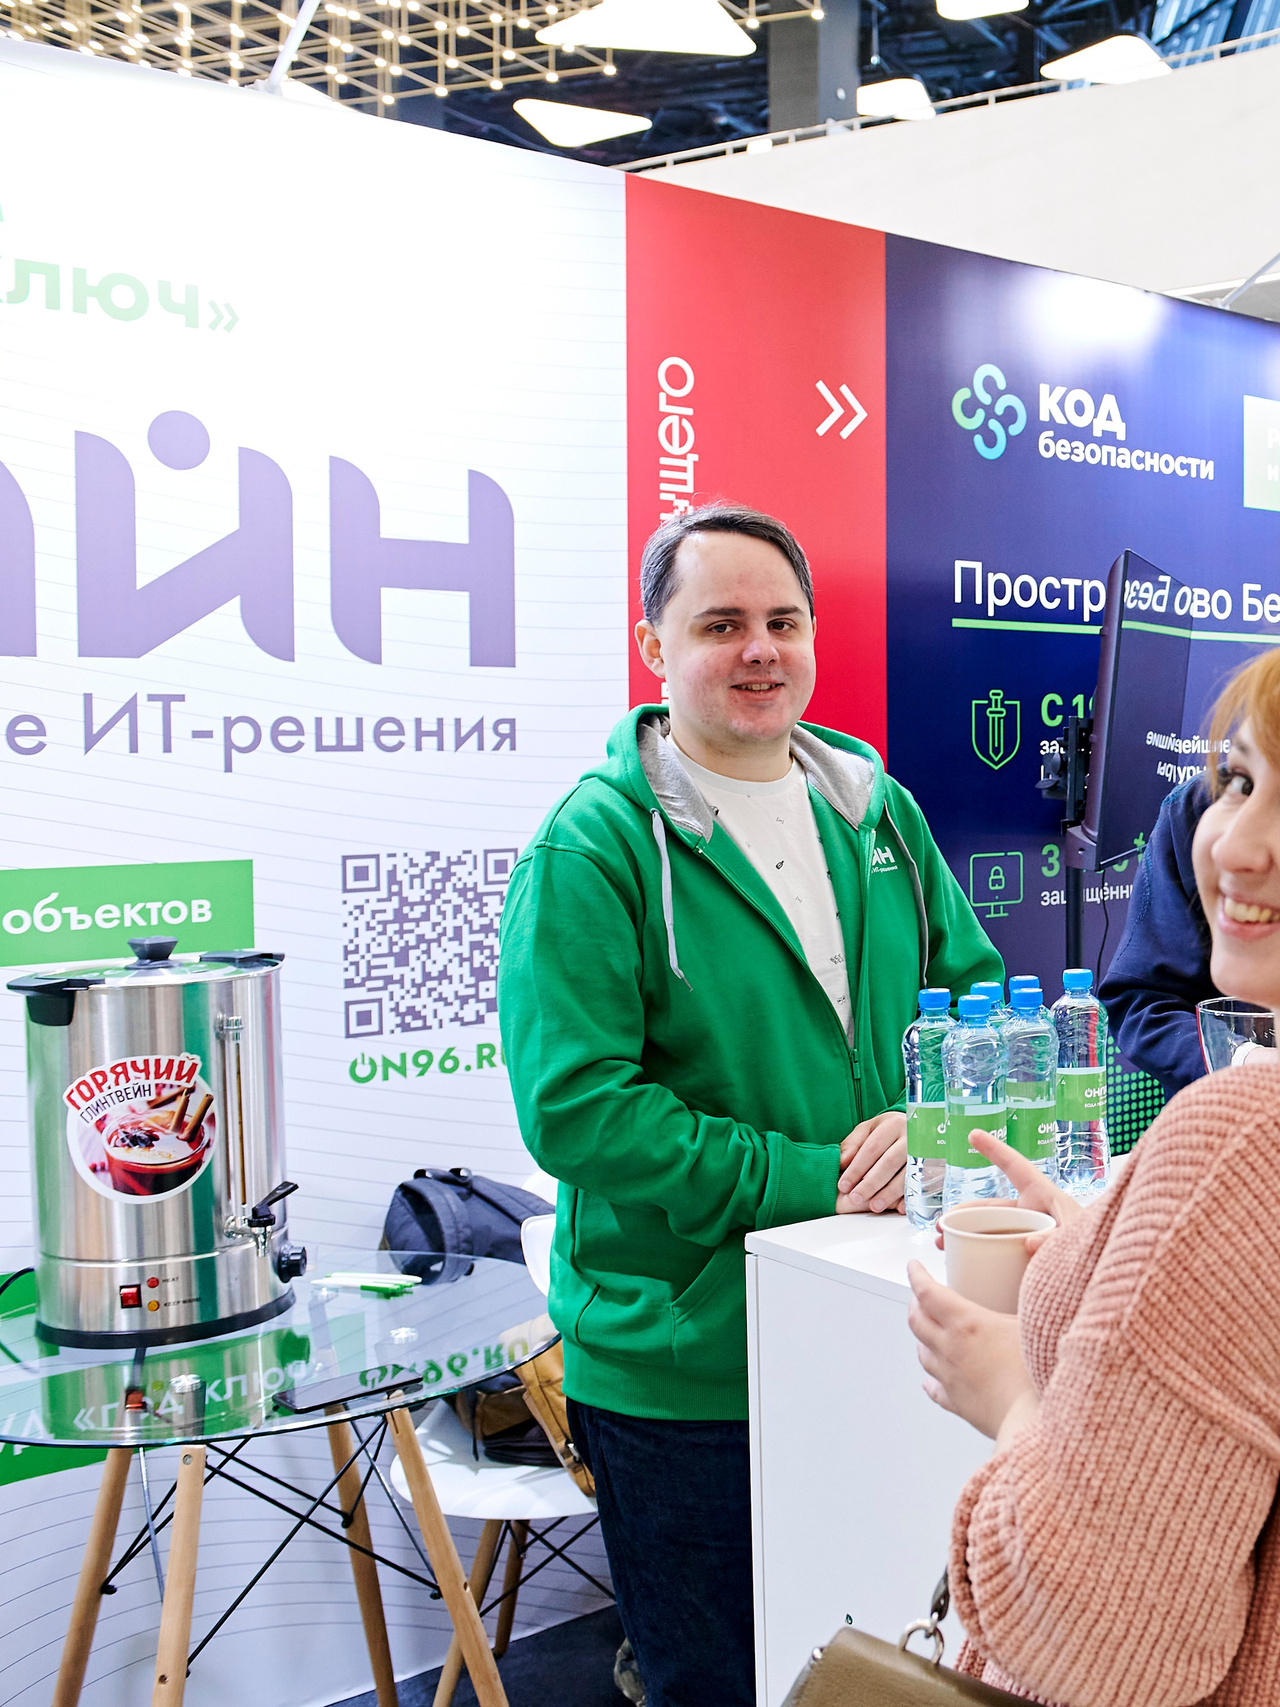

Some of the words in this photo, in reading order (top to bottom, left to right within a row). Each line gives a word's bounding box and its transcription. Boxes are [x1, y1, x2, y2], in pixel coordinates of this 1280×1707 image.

[0, 256, 240, 333] ЛЮЧ»
[1039, 383, 1126, 441] КОД
[1038, 430, 1215, 481] безопасности
[1267, 464, 1279, 481] и
[84, 692, 516, 773] ИТ-решения
[2, 892, 213, 935] объектов
[66, 1055, 199, 1111] ГОРЯЧИЙ
[349, 1043, 507, 1084] ON96.R
[79, 1083, 152, 1124] ГЛИНТВЕЙН
